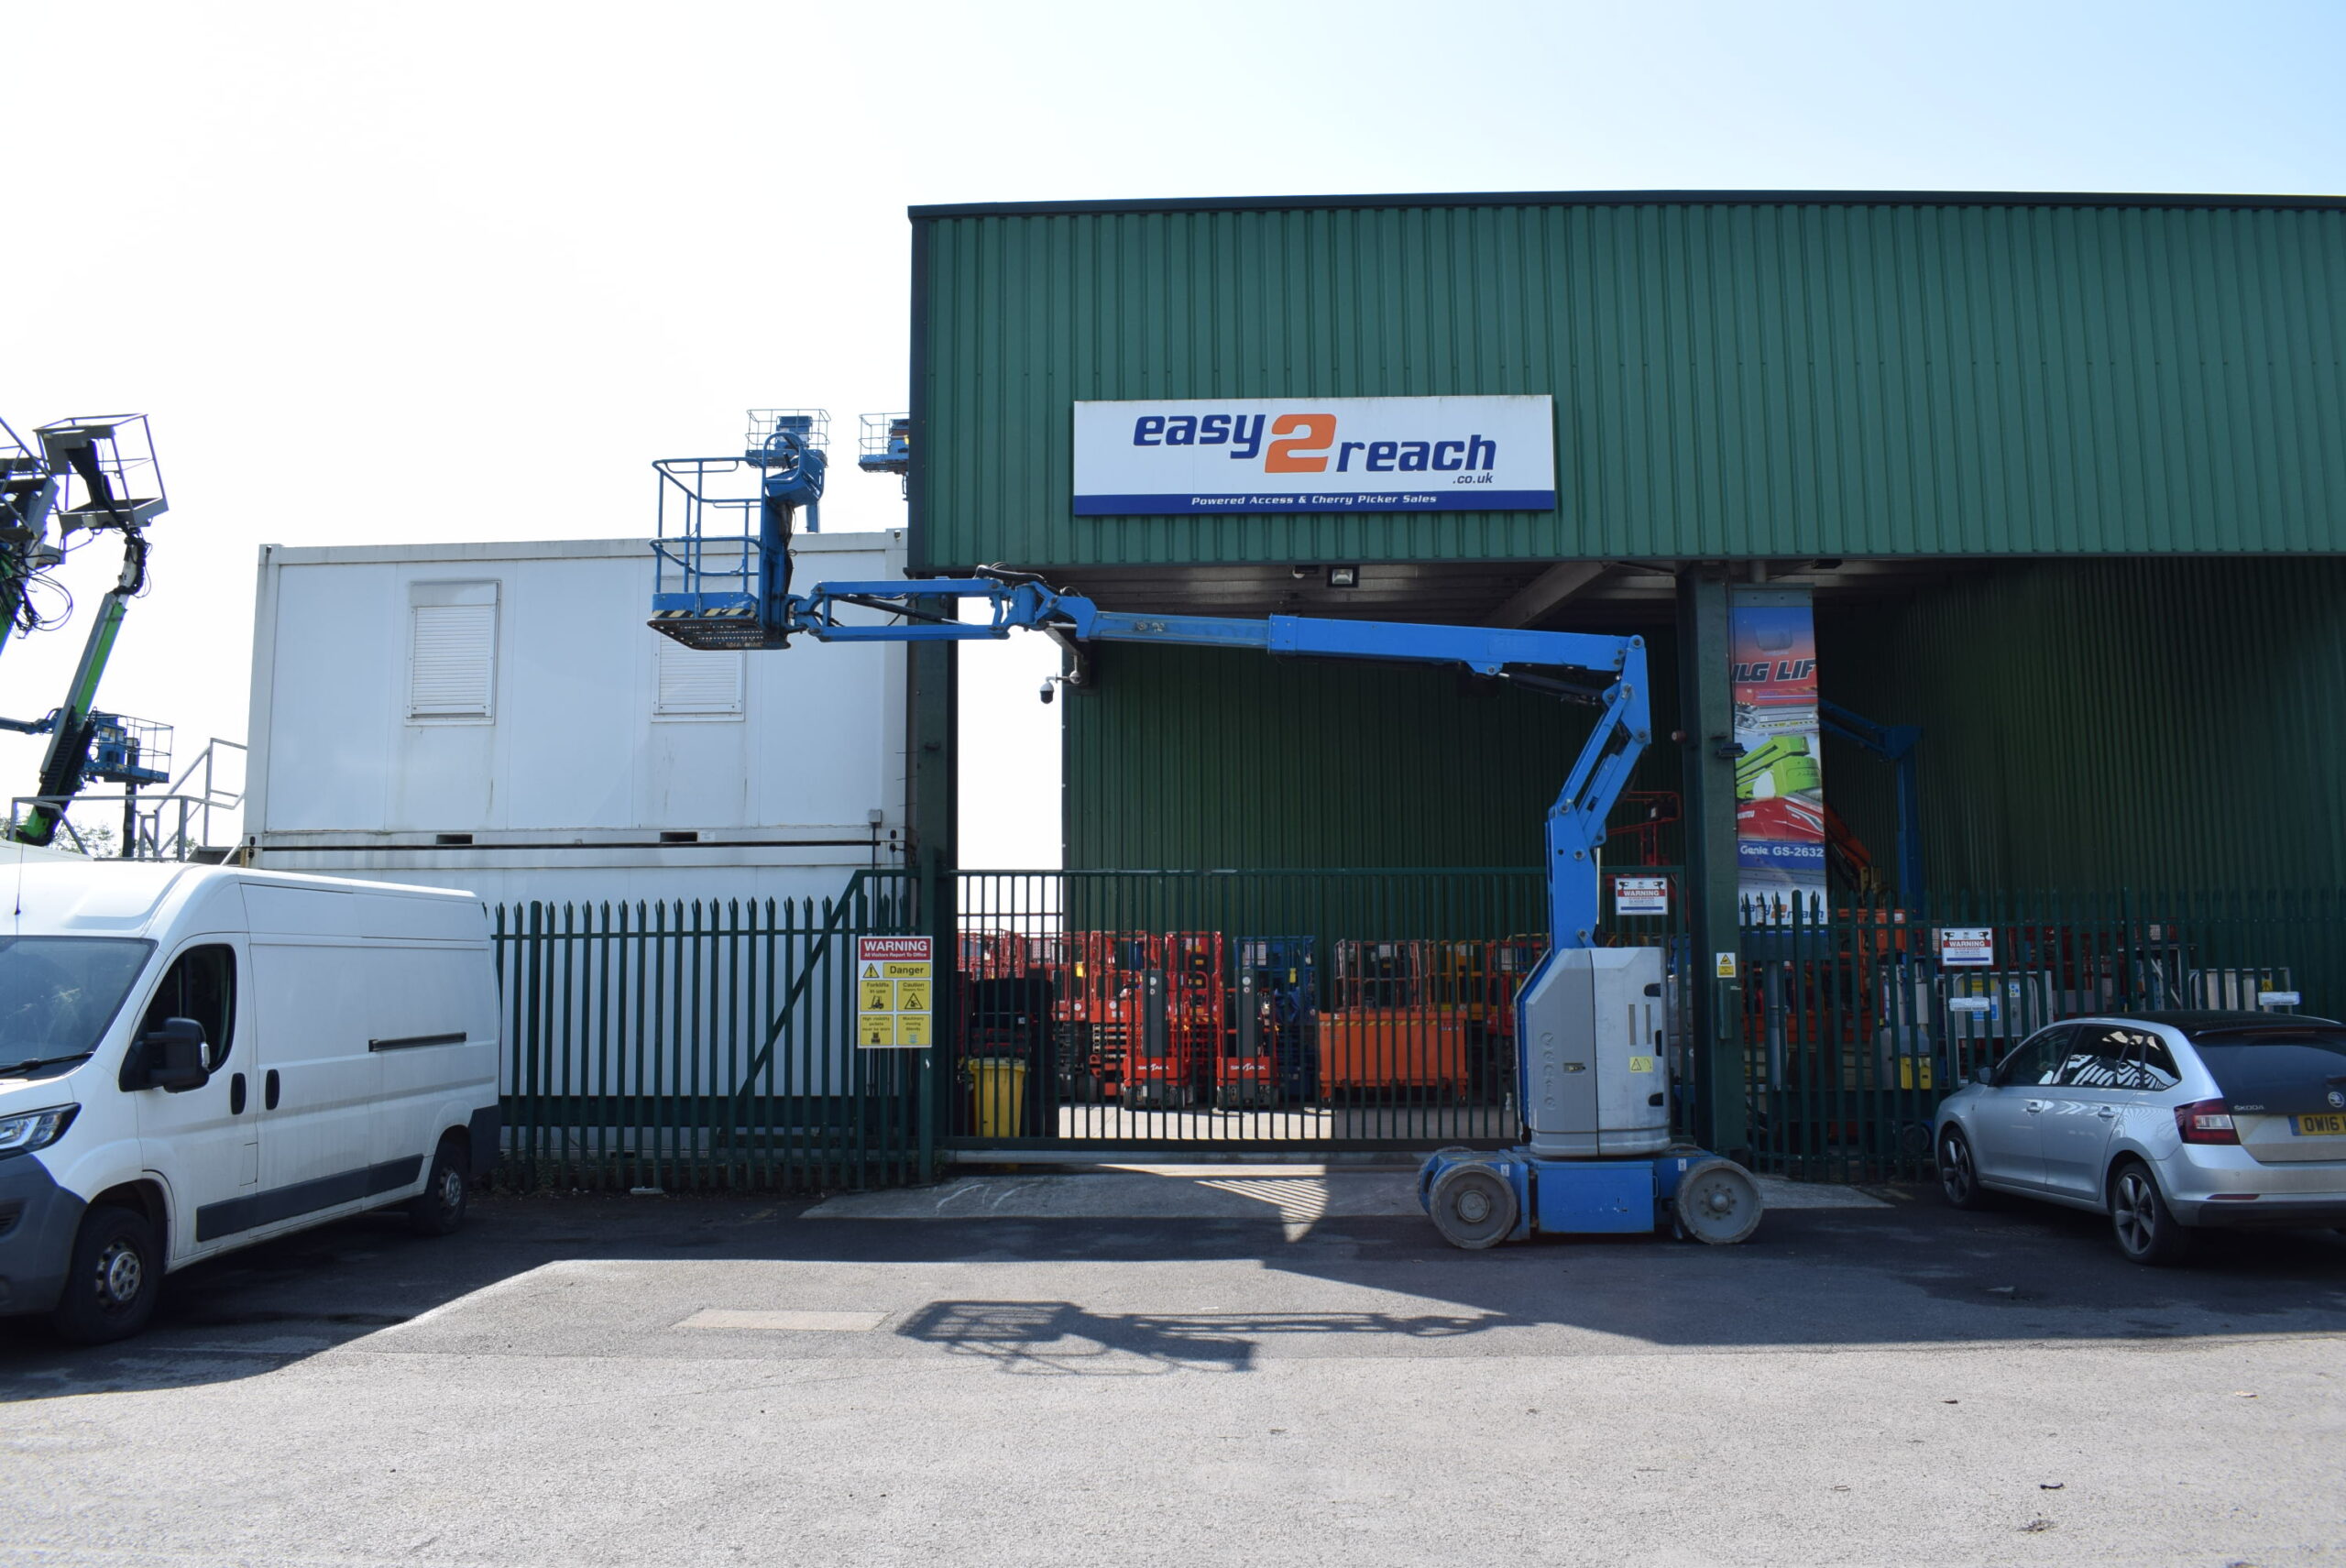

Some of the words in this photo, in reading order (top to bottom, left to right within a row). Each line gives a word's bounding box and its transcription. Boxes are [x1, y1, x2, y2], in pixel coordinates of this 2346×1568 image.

[1453, 472, 1494, 485] .co.uk
[1191, 497, 1245, 506] Powered
[1249, 496, 1294, 505] Access
[1298, 496, 1307, 504] &
[1311, 495, 1354, 506] Cherry
[1357, 495, 1398, 504] Picker
[1402, 495, 1437, 503] Sales
[1740, 845, 1769, 855] Genie
[1772, 846, 1824, 858] GS-2632
[864, 941, 927, 951] WARNING
[890, 966, 924, 976] Danger
